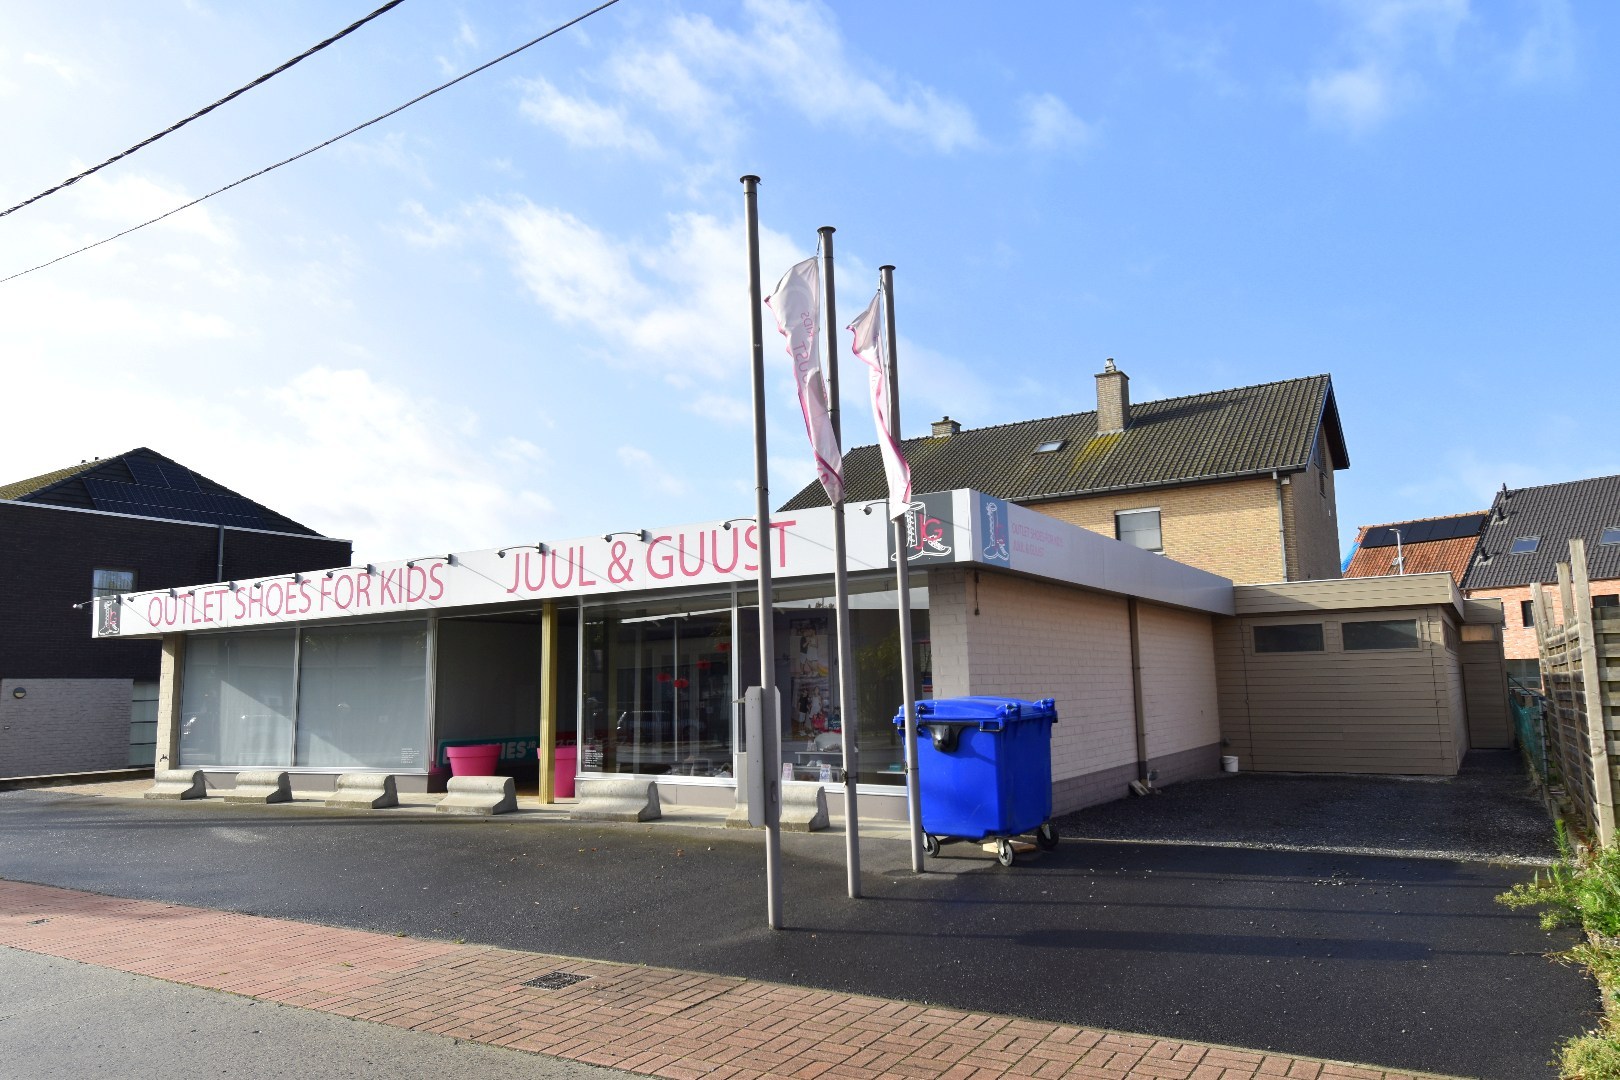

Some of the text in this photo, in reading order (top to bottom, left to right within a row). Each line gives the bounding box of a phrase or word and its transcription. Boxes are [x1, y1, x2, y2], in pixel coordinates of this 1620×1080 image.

[507, 520, 796, 593] JUUL & GUUST
[148, 563, 444, 627] OUTLET SHOES FOR KIDS
